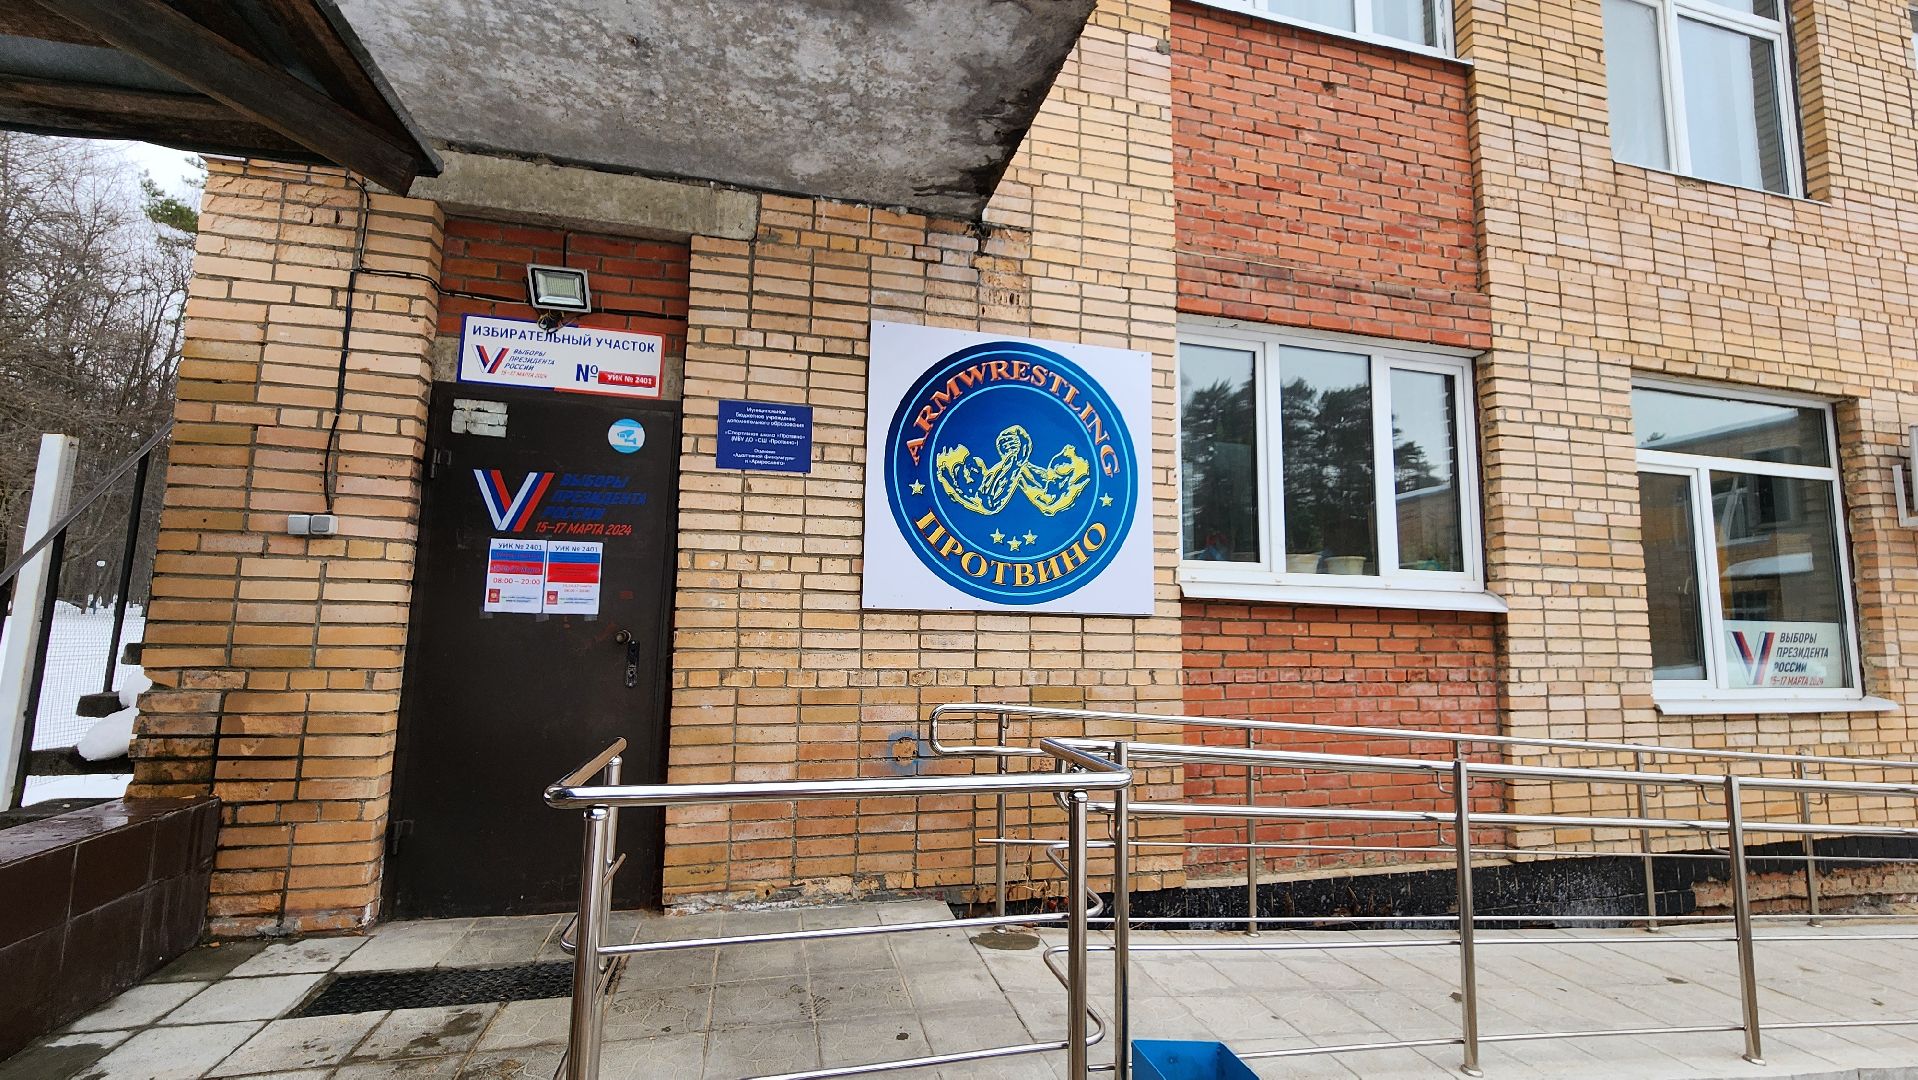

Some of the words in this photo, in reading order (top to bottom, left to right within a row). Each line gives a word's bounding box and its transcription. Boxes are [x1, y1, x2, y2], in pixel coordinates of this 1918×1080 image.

[472, 325, 592, 347] ИЗБИРАТЕЛЬНЫЙ
[595, 337, 655, 353] УЧАСТОК
[513, 348, 547, 357] ВЫБОРЫ
[503, 362, 535, 371] РОССИИ
[508, 355, 556, 366] ПРЕЗИДЕНТА
[575, 363, 599, 383] №
[624, 375, 634, 383] №
[634, 376, 652, 385] 2401
[906, 359, 1121, 478] ARMWRESTLING
[560, 472, 630, 489] ВЫБОРЫ
[566, 522, 604, 536] МАРТА
[605, 524, 632, 536] 2024
[525, 543, 542, 551] 2401
[581, 545, 598, 553] 2401
[914, 508, 1108, 587] ПРОТВИНО
[1779, 632, 1818, 644] ВЫБОРЫ
[1776, 646, 1830, 659] ПРЕЗИДЕНТА
[1773, 661, 1808, 673] РОССИИ
[1788, 676, 1809, 686] МАРТА
[1809, 677, 1825, 686] 2024
